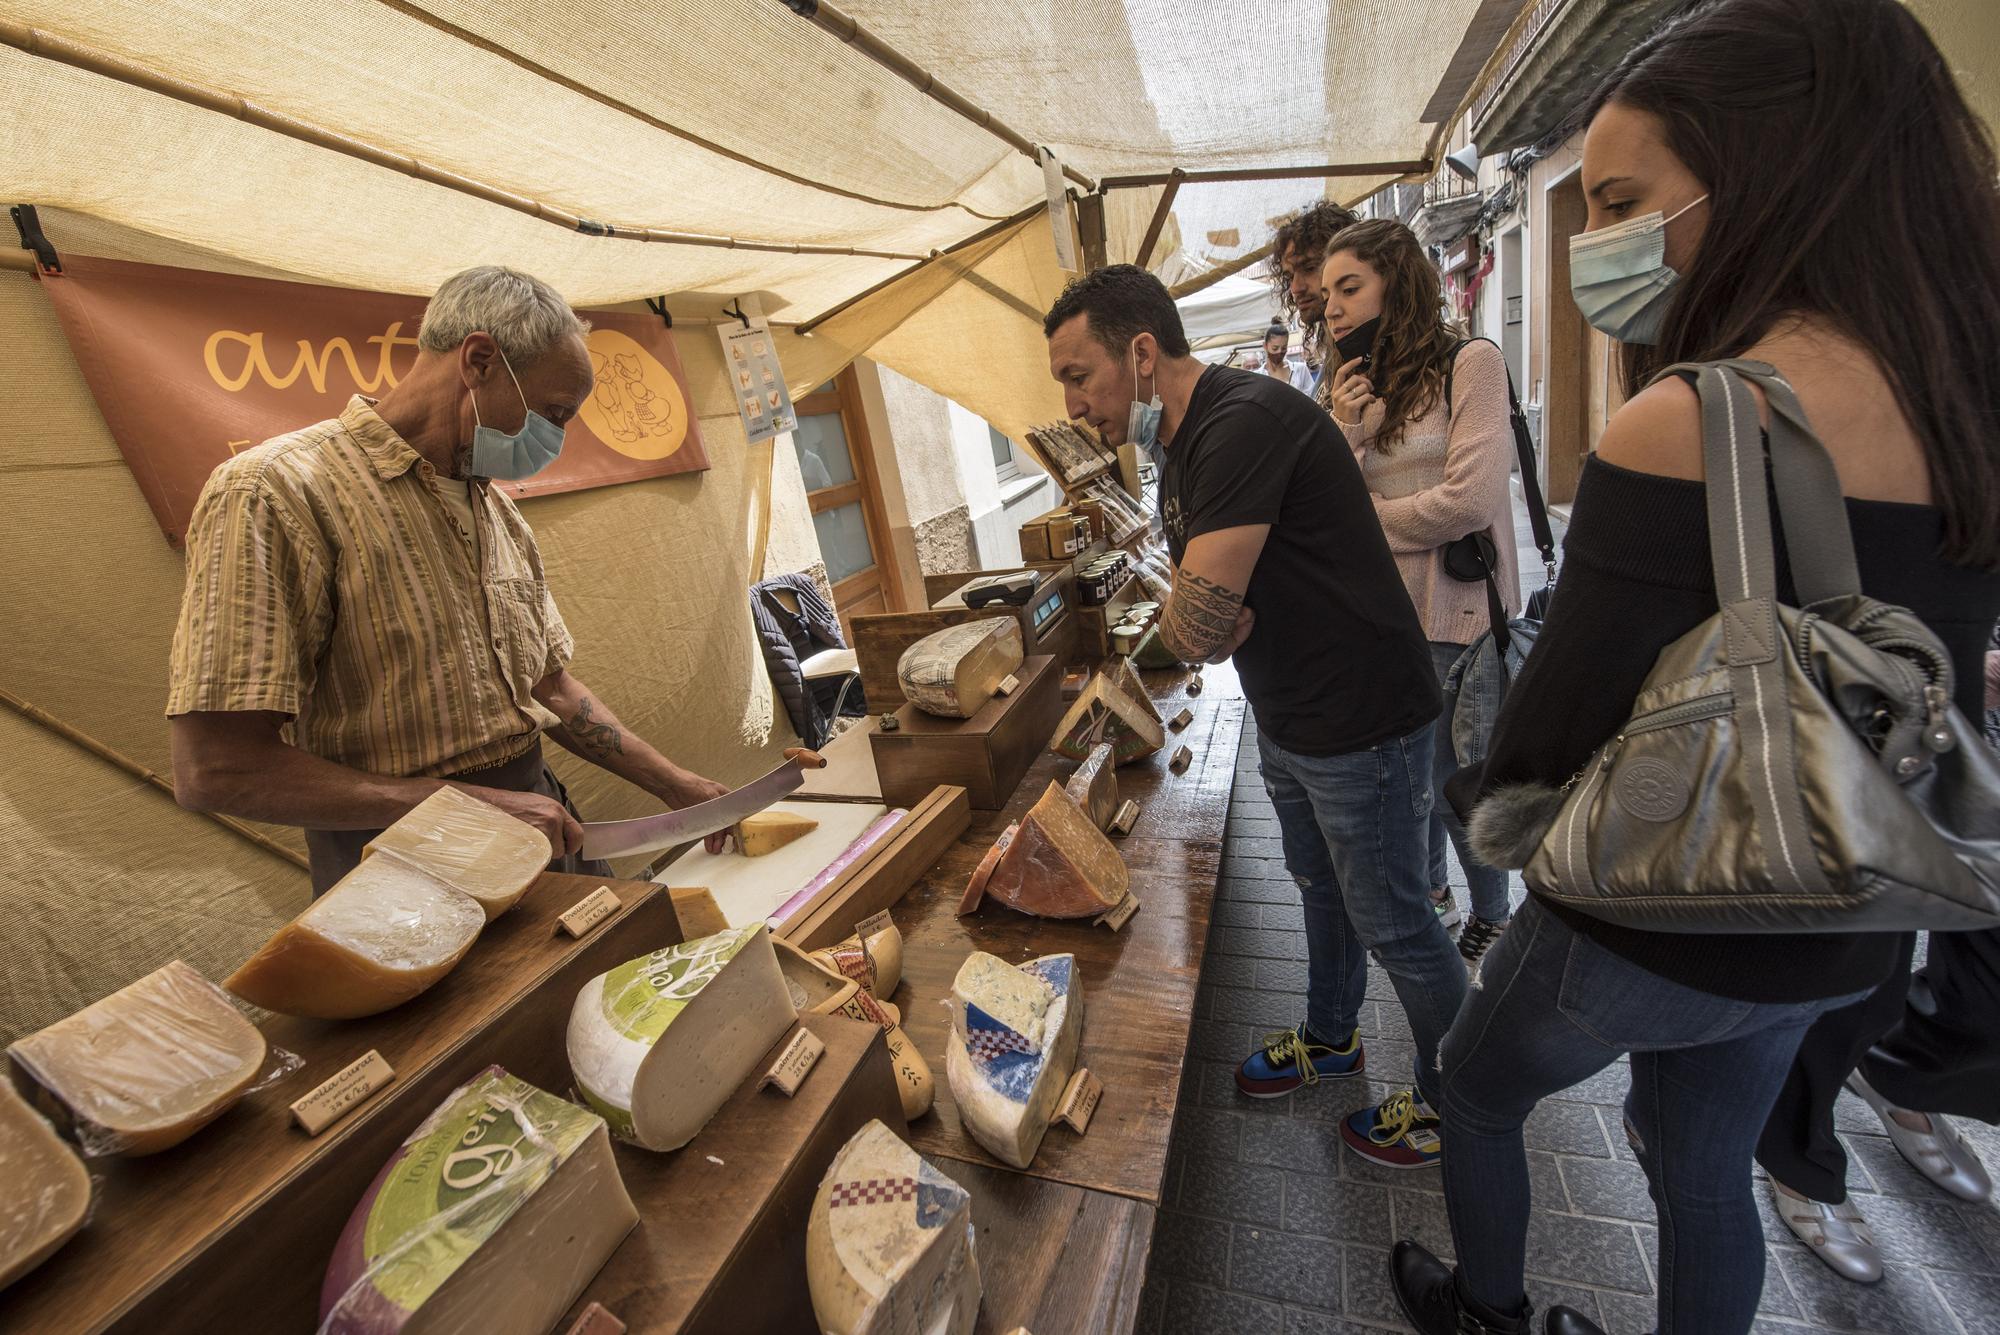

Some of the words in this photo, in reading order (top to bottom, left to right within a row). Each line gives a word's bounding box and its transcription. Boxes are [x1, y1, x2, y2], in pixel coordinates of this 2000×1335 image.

[563, 902, 588, 921] Ovella
[297, 1080, 339, 1112] Ovella
[338, 1055, 375, 1081] Curat
[344, 1082, 371, 1102] €/kg
